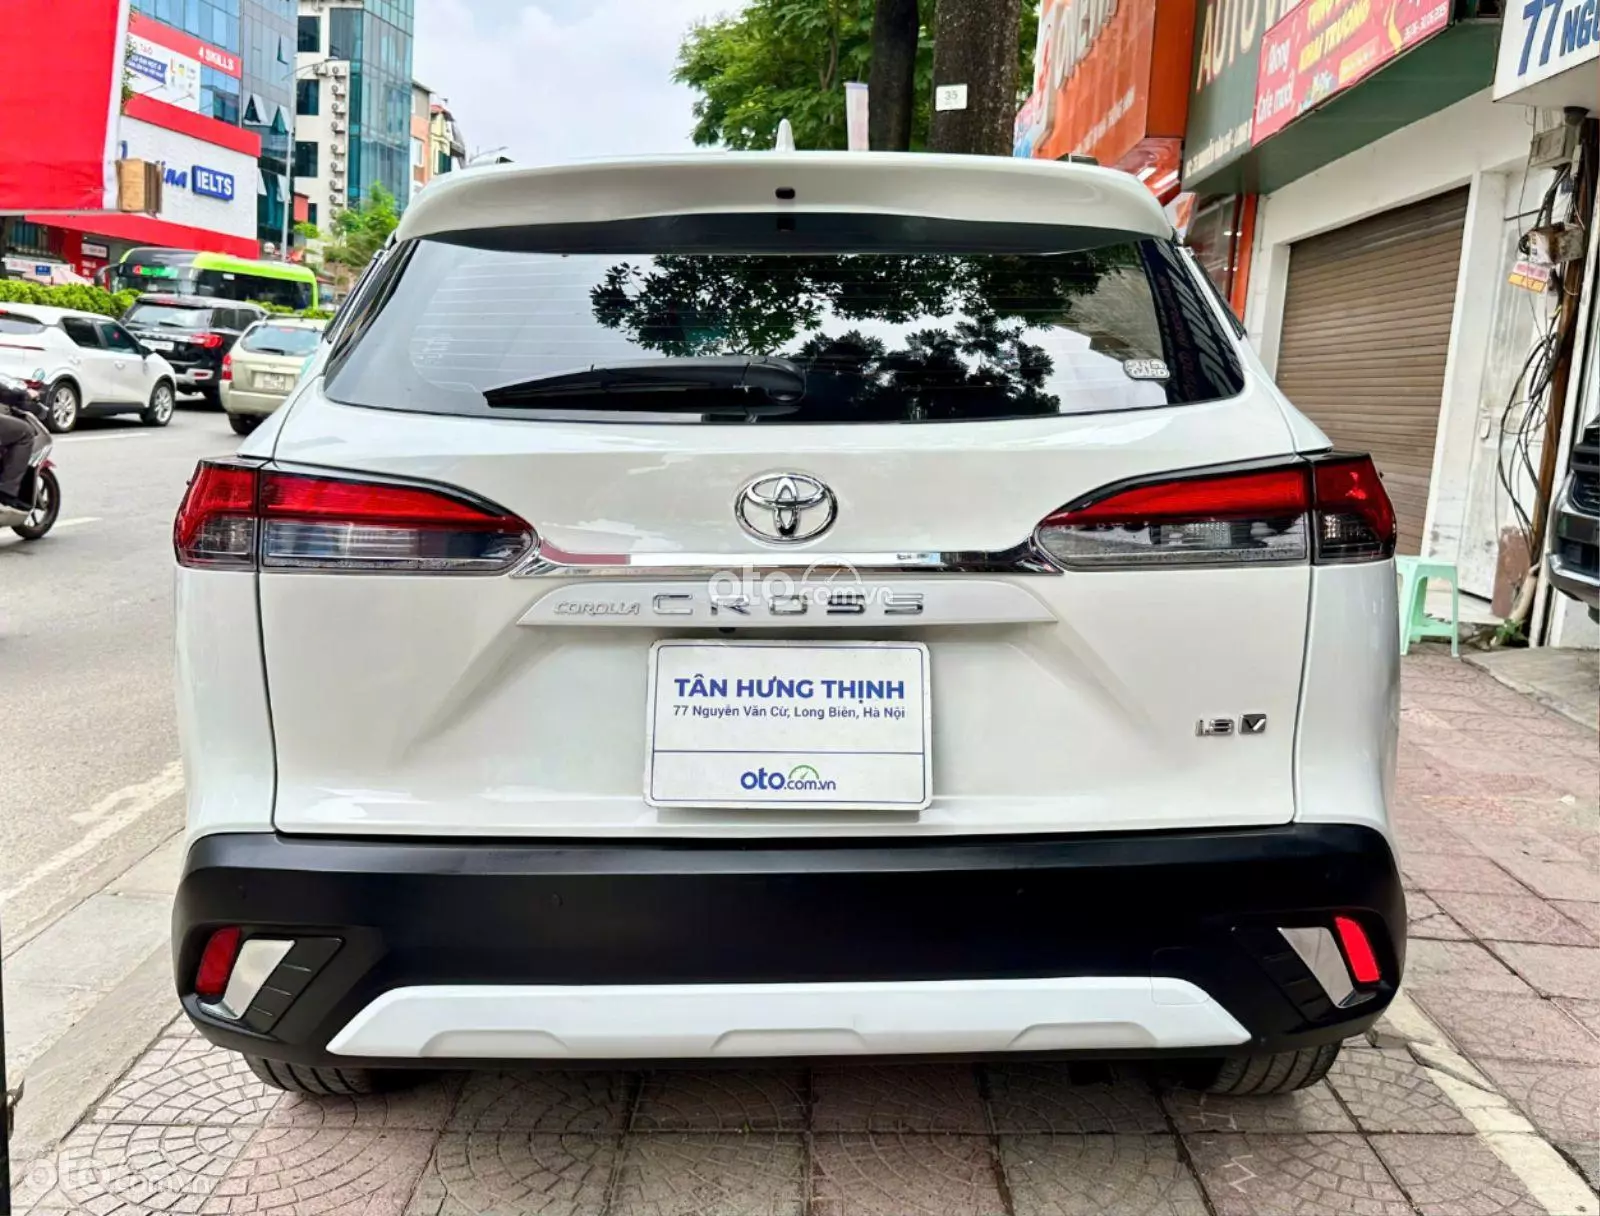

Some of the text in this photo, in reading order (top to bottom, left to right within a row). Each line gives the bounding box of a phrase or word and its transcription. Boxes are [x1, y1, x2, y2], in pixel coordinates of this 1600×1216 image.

[1518, 0, 1564, 76] 77
[198, 46, 234, 71] 4 SKILLS
[196, 169, 232, 195] IELTS
[553, 594, 923, 616] COROLLA CROSS
[674, 673, 904, 704] TÂN HƯNG THỊNH
[673, 705, 689, 716] 77
[743, 705, 767, 717] Văn
[769, 706, 790, 719] Cừ,
[794, 706, 825, 720] Long
[828, 706, 860, 720] Biên,
[863, 707, 880, 718] Hà
[884, 706, 905, 720] Nội
[740, 767, 837, 790] oto.com.vn
